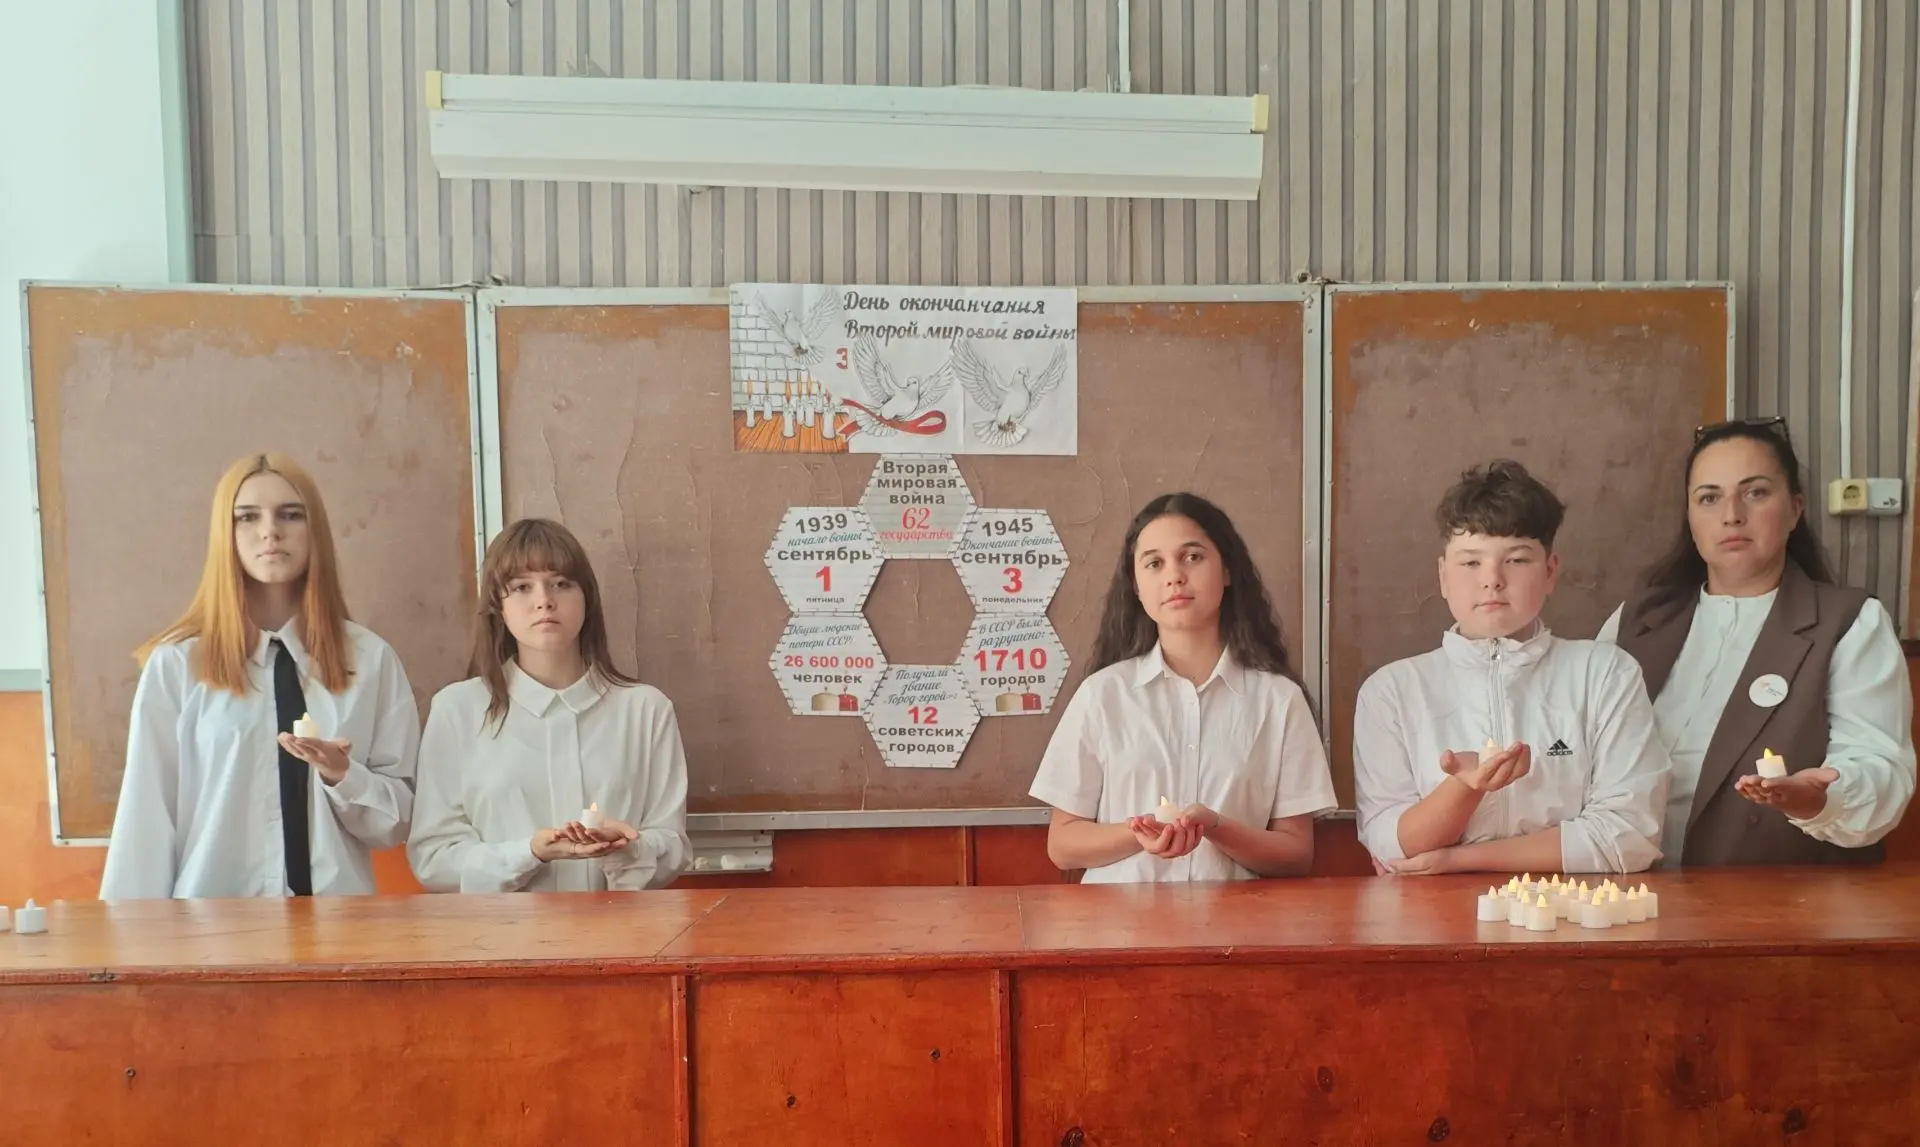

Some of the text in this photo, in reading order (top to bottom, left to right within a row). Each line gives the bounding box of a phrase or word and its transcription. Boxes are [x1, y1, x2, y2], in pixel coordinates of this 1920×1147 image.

[843, 291, 890, 311] День
[844, 319, 1076, 350] Второй мировой войны
[836, 347, 848, 369] 3
[883, 461, 948, 477] Вторая
[877, 478, 957, 491] мировая
[889, 491, 945, 504] война
[796, 513, 848, 534] 1939
[902, 507, 931, 530] 62
[878, 528, 955, 543] государства
[982, 518, 1034, 538] 1945
[787, 531, 863, 547] начало войны
[1021, 535, 1054, 547] войны
[777, 547, 872, 564] сентябрь
[961, 550, 1062, 569] сентябрь
[815, 566, 832, 592] 1
[1002, 567, 1023, 594] 3
[788, 623, 863, 637] Общие людские
[978, 617, 1044, 635] В СССР было
[788, 638, 825, 650] потери
[978, 630, 1046, 649] разрушено:
[784, 655, 874, 668] 26 600 000
[973, 648, 1047, 672] 1710
[793, 673, 862, 684] человек
[895, 669, 948, 682] Получили
[980, 675, 1046, 688] городов
[901, 680, 941, 696] звание
[908, 706, 938, 724] 12
[878, 727, 964, 738] советских
[889, 743, 955, 755] городов
